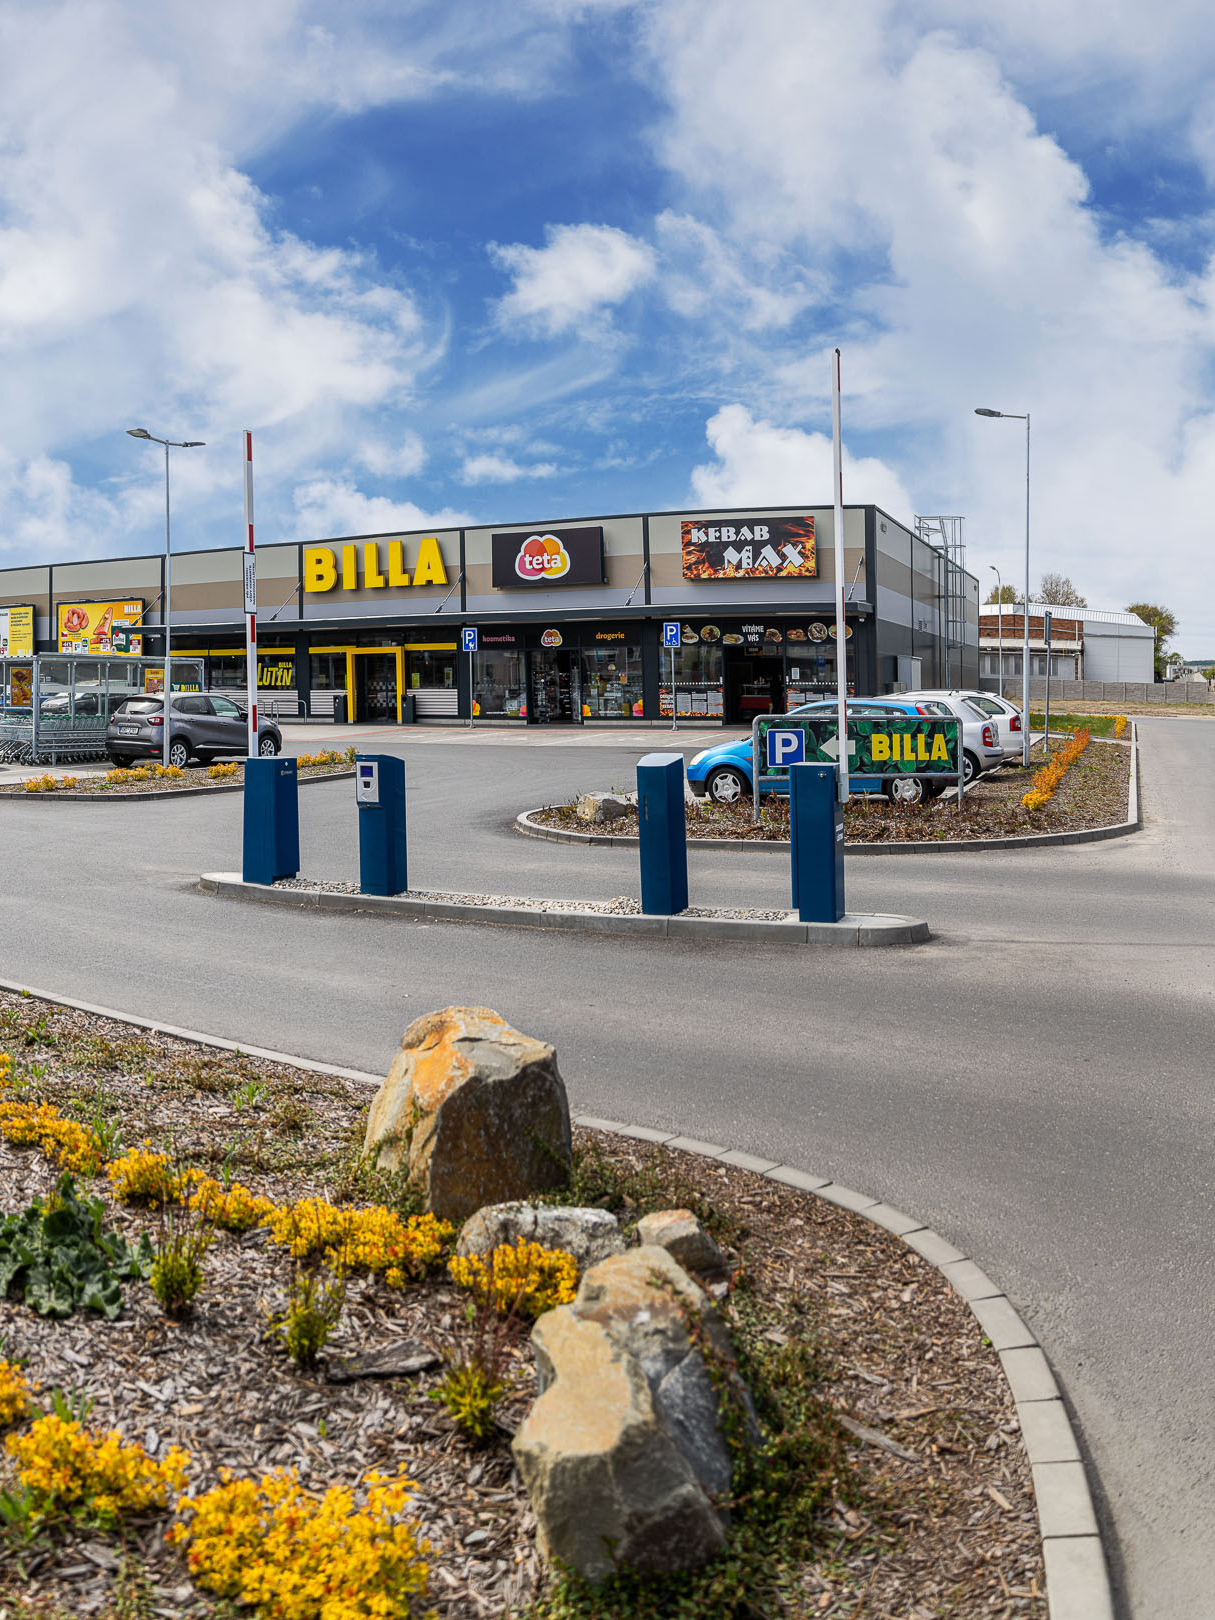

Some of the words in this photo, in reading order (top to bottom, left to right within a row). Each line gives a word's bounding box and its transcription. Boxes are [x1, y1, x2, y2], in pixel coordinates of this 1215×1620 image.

[691, 526, 770, 543] KEBAB
[524, 552, 562, 570] teta
[723, 543, 805, 569] MAX
[304, 537, 449, 592] BILLA
[123, 604, 141, 613] BILLA
[667, 626, 676, 640] P
[742, 624, 765, 633] VÍTÁME
[466, 631, 474, 644] P
[482, 635, 516, 643] kosmetika
[544, 634, 560, 643] teta
[595, 631, 625, 641] drogerie
[747, 632, 760, 642] VÁS
[180, 684, 200, 692] BILLA
[775, 732, 799, 764] P
[871, 733, 949, 761] BILLA
